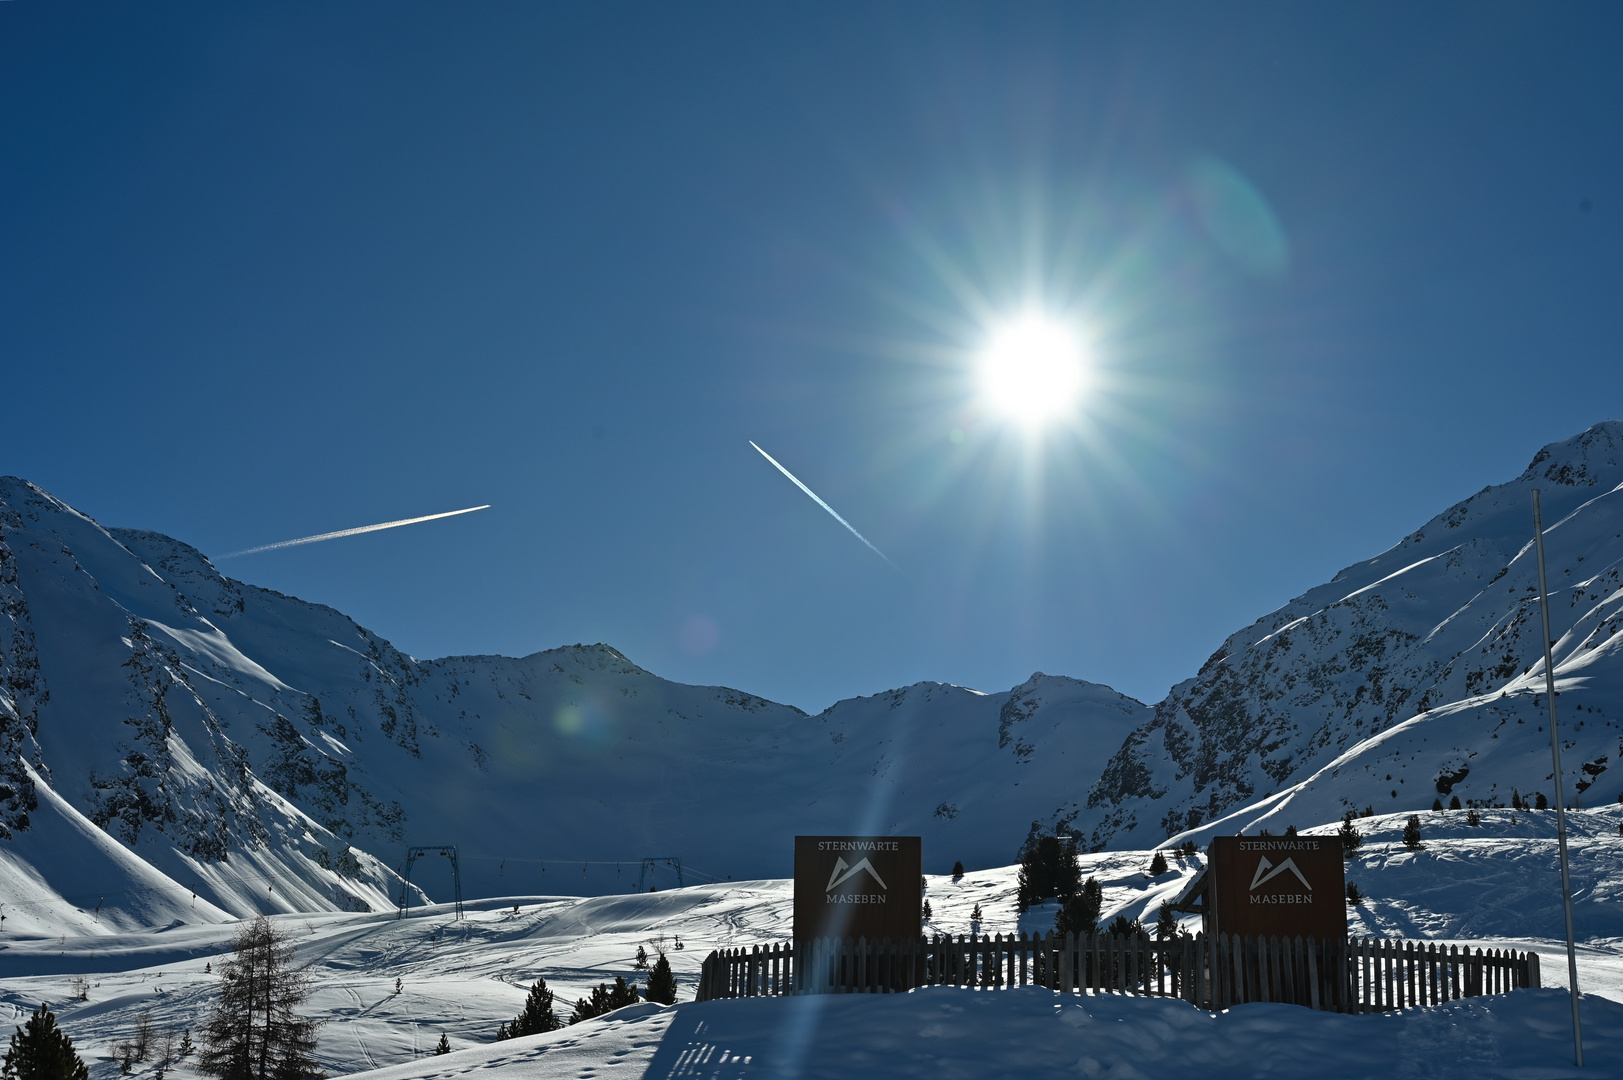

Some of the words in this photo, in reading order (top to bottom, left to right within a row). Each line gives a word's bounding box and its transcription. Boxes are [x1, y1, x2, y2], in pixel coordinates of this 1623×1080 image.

[818, 841, 899, 851] STERNWARTE
[1239, 841, 1320, 851] STERNWARTE
[826, 894, 886, 904] MASEBEN
[1249, 894, 1313, 904] MASEBEN
